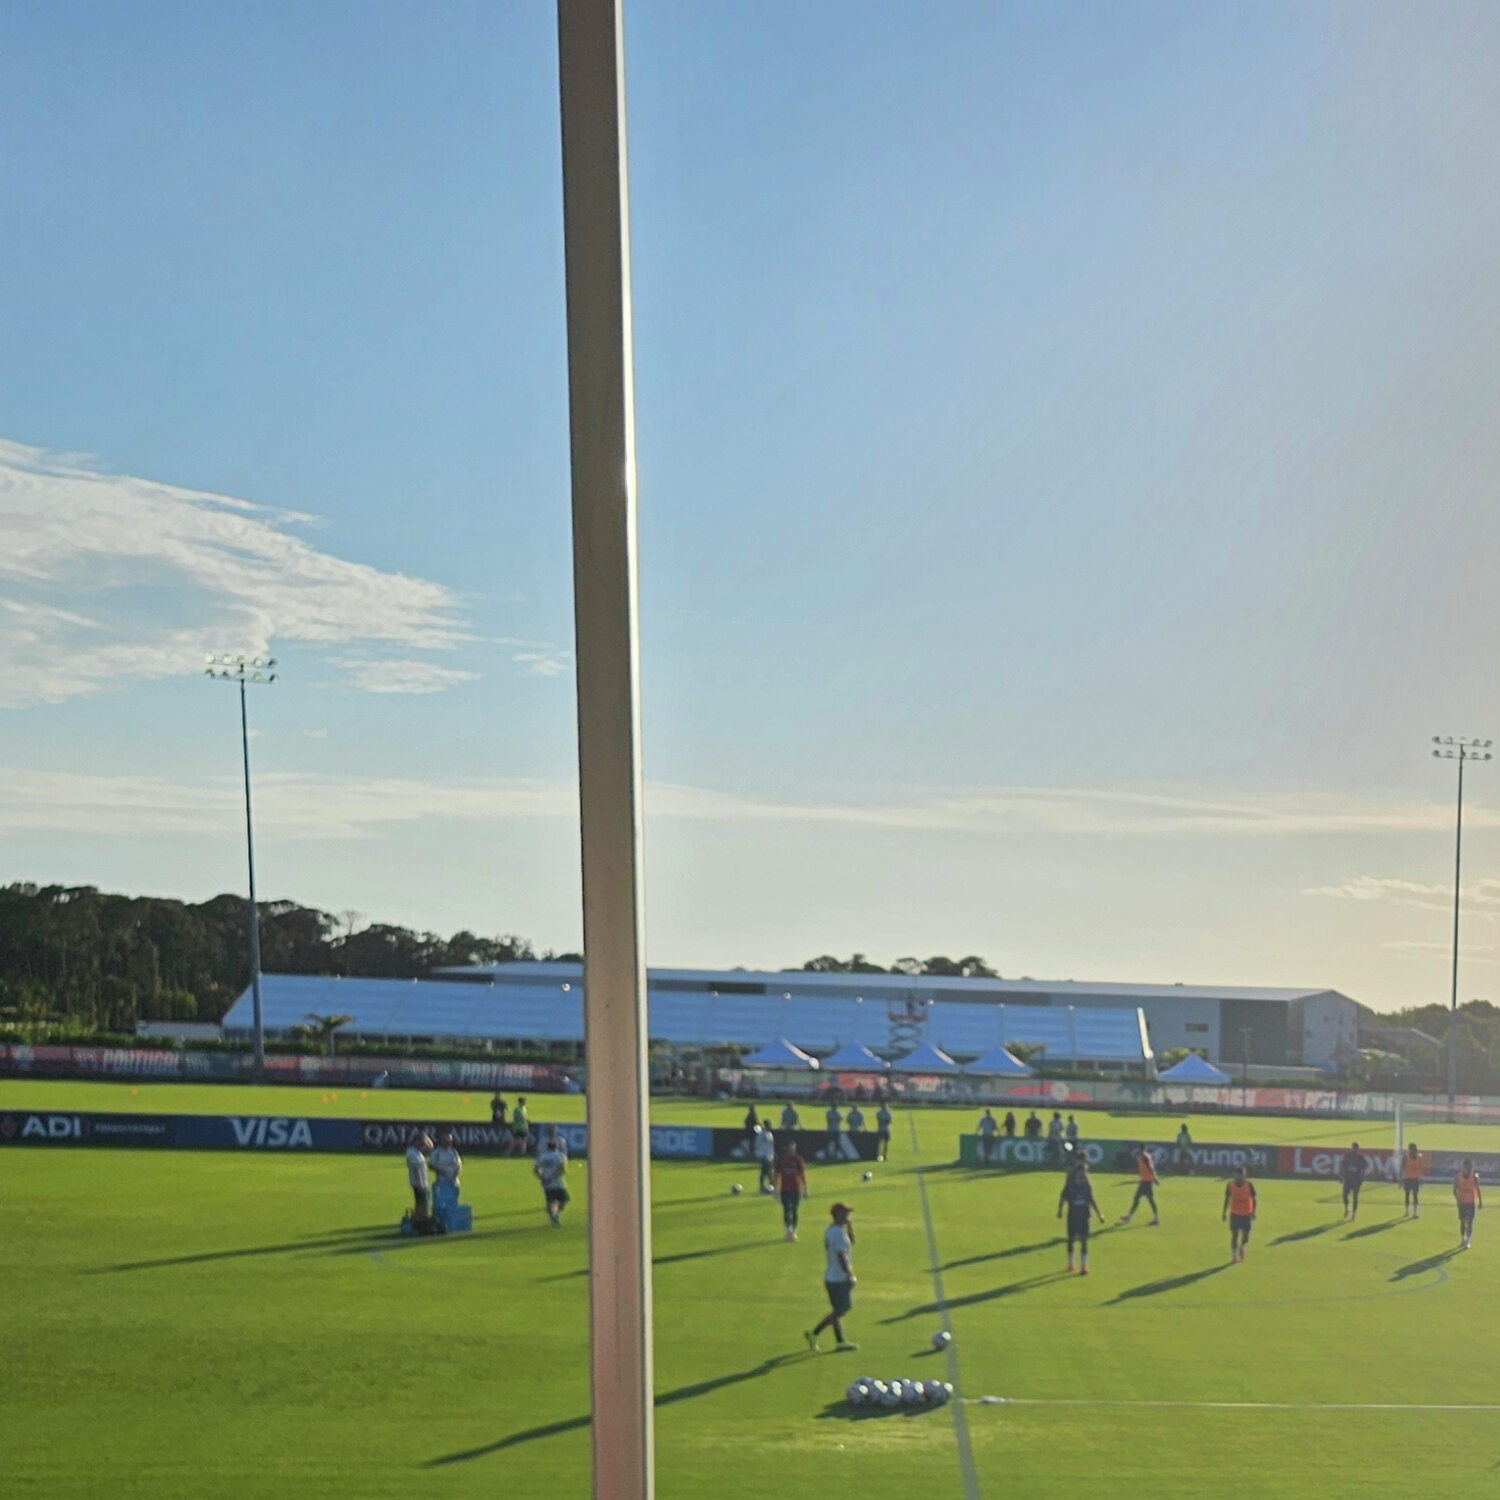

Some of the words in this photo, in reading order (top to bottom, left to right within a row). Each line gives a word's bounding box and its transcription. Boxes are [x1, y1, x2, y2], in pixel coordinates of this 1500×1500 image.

[22, 1115, 82, 1138] ADI
[230, 1118, 314, 1147] VISA
[451, 1126, 537, 1148] AIRWAS
